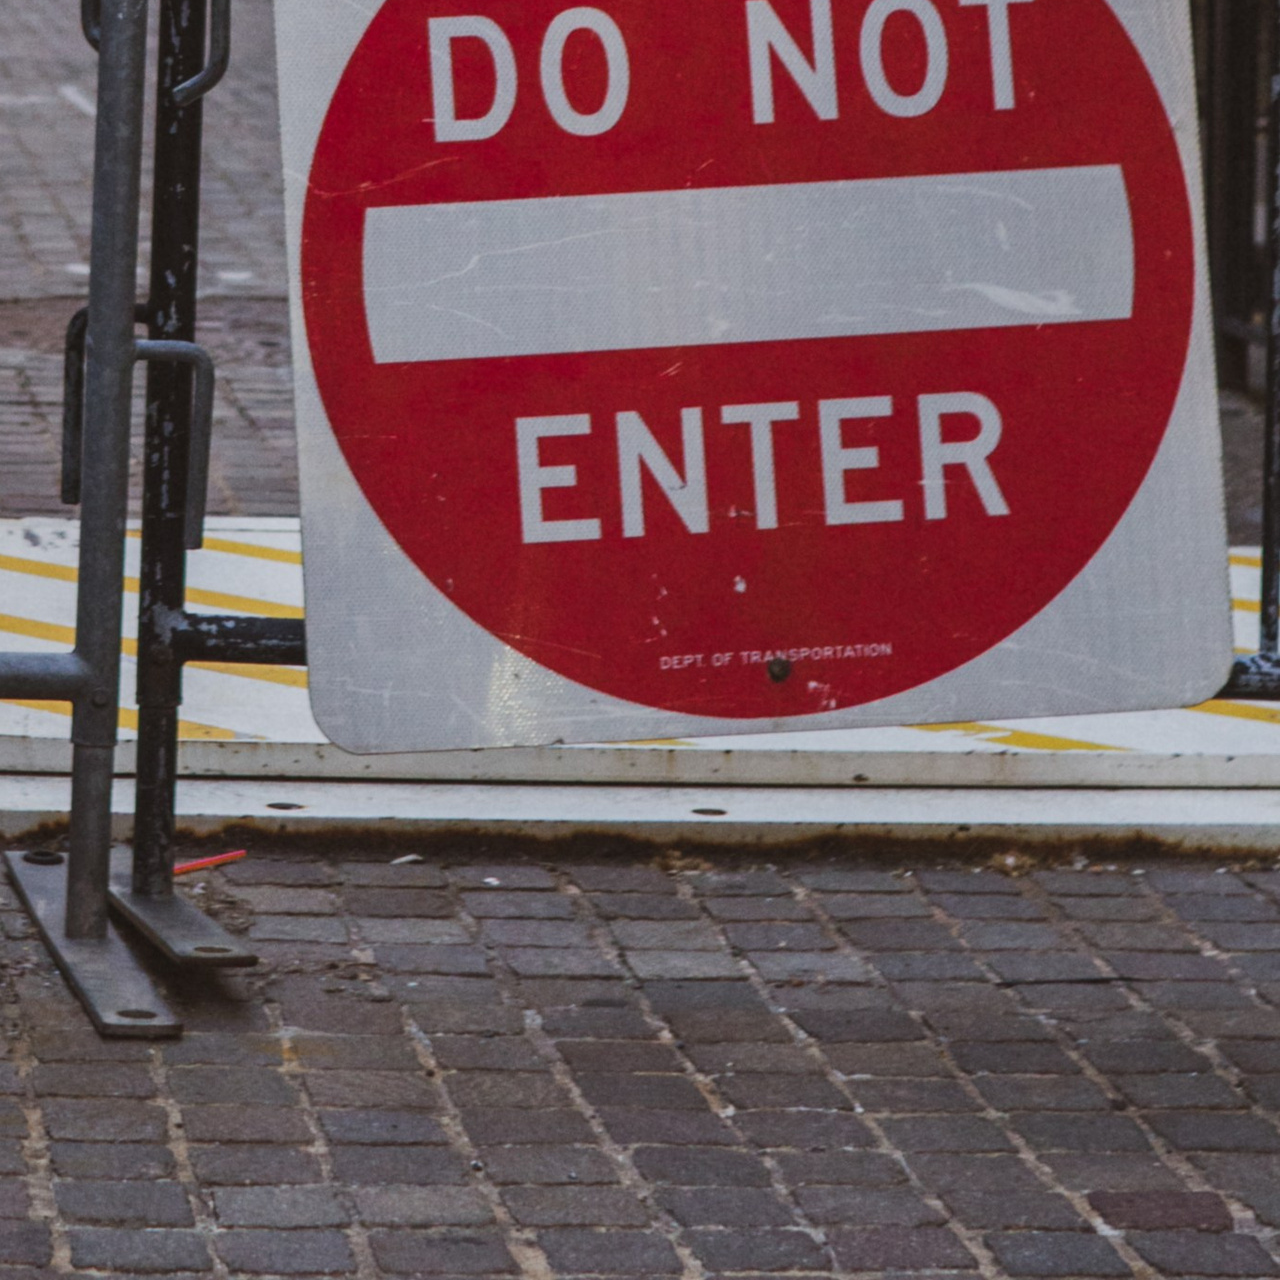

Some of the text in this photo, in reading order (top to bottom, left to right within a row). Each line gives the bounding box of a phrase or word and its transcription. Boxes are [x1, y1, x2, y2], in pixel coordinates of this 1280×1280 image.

[427, 6, 630, 143] DO
[515, 391, 1011, 544] ENTER
[711, 651, 734, 667] OF
[739, 642, 893, 665] TRANSPORTATION
